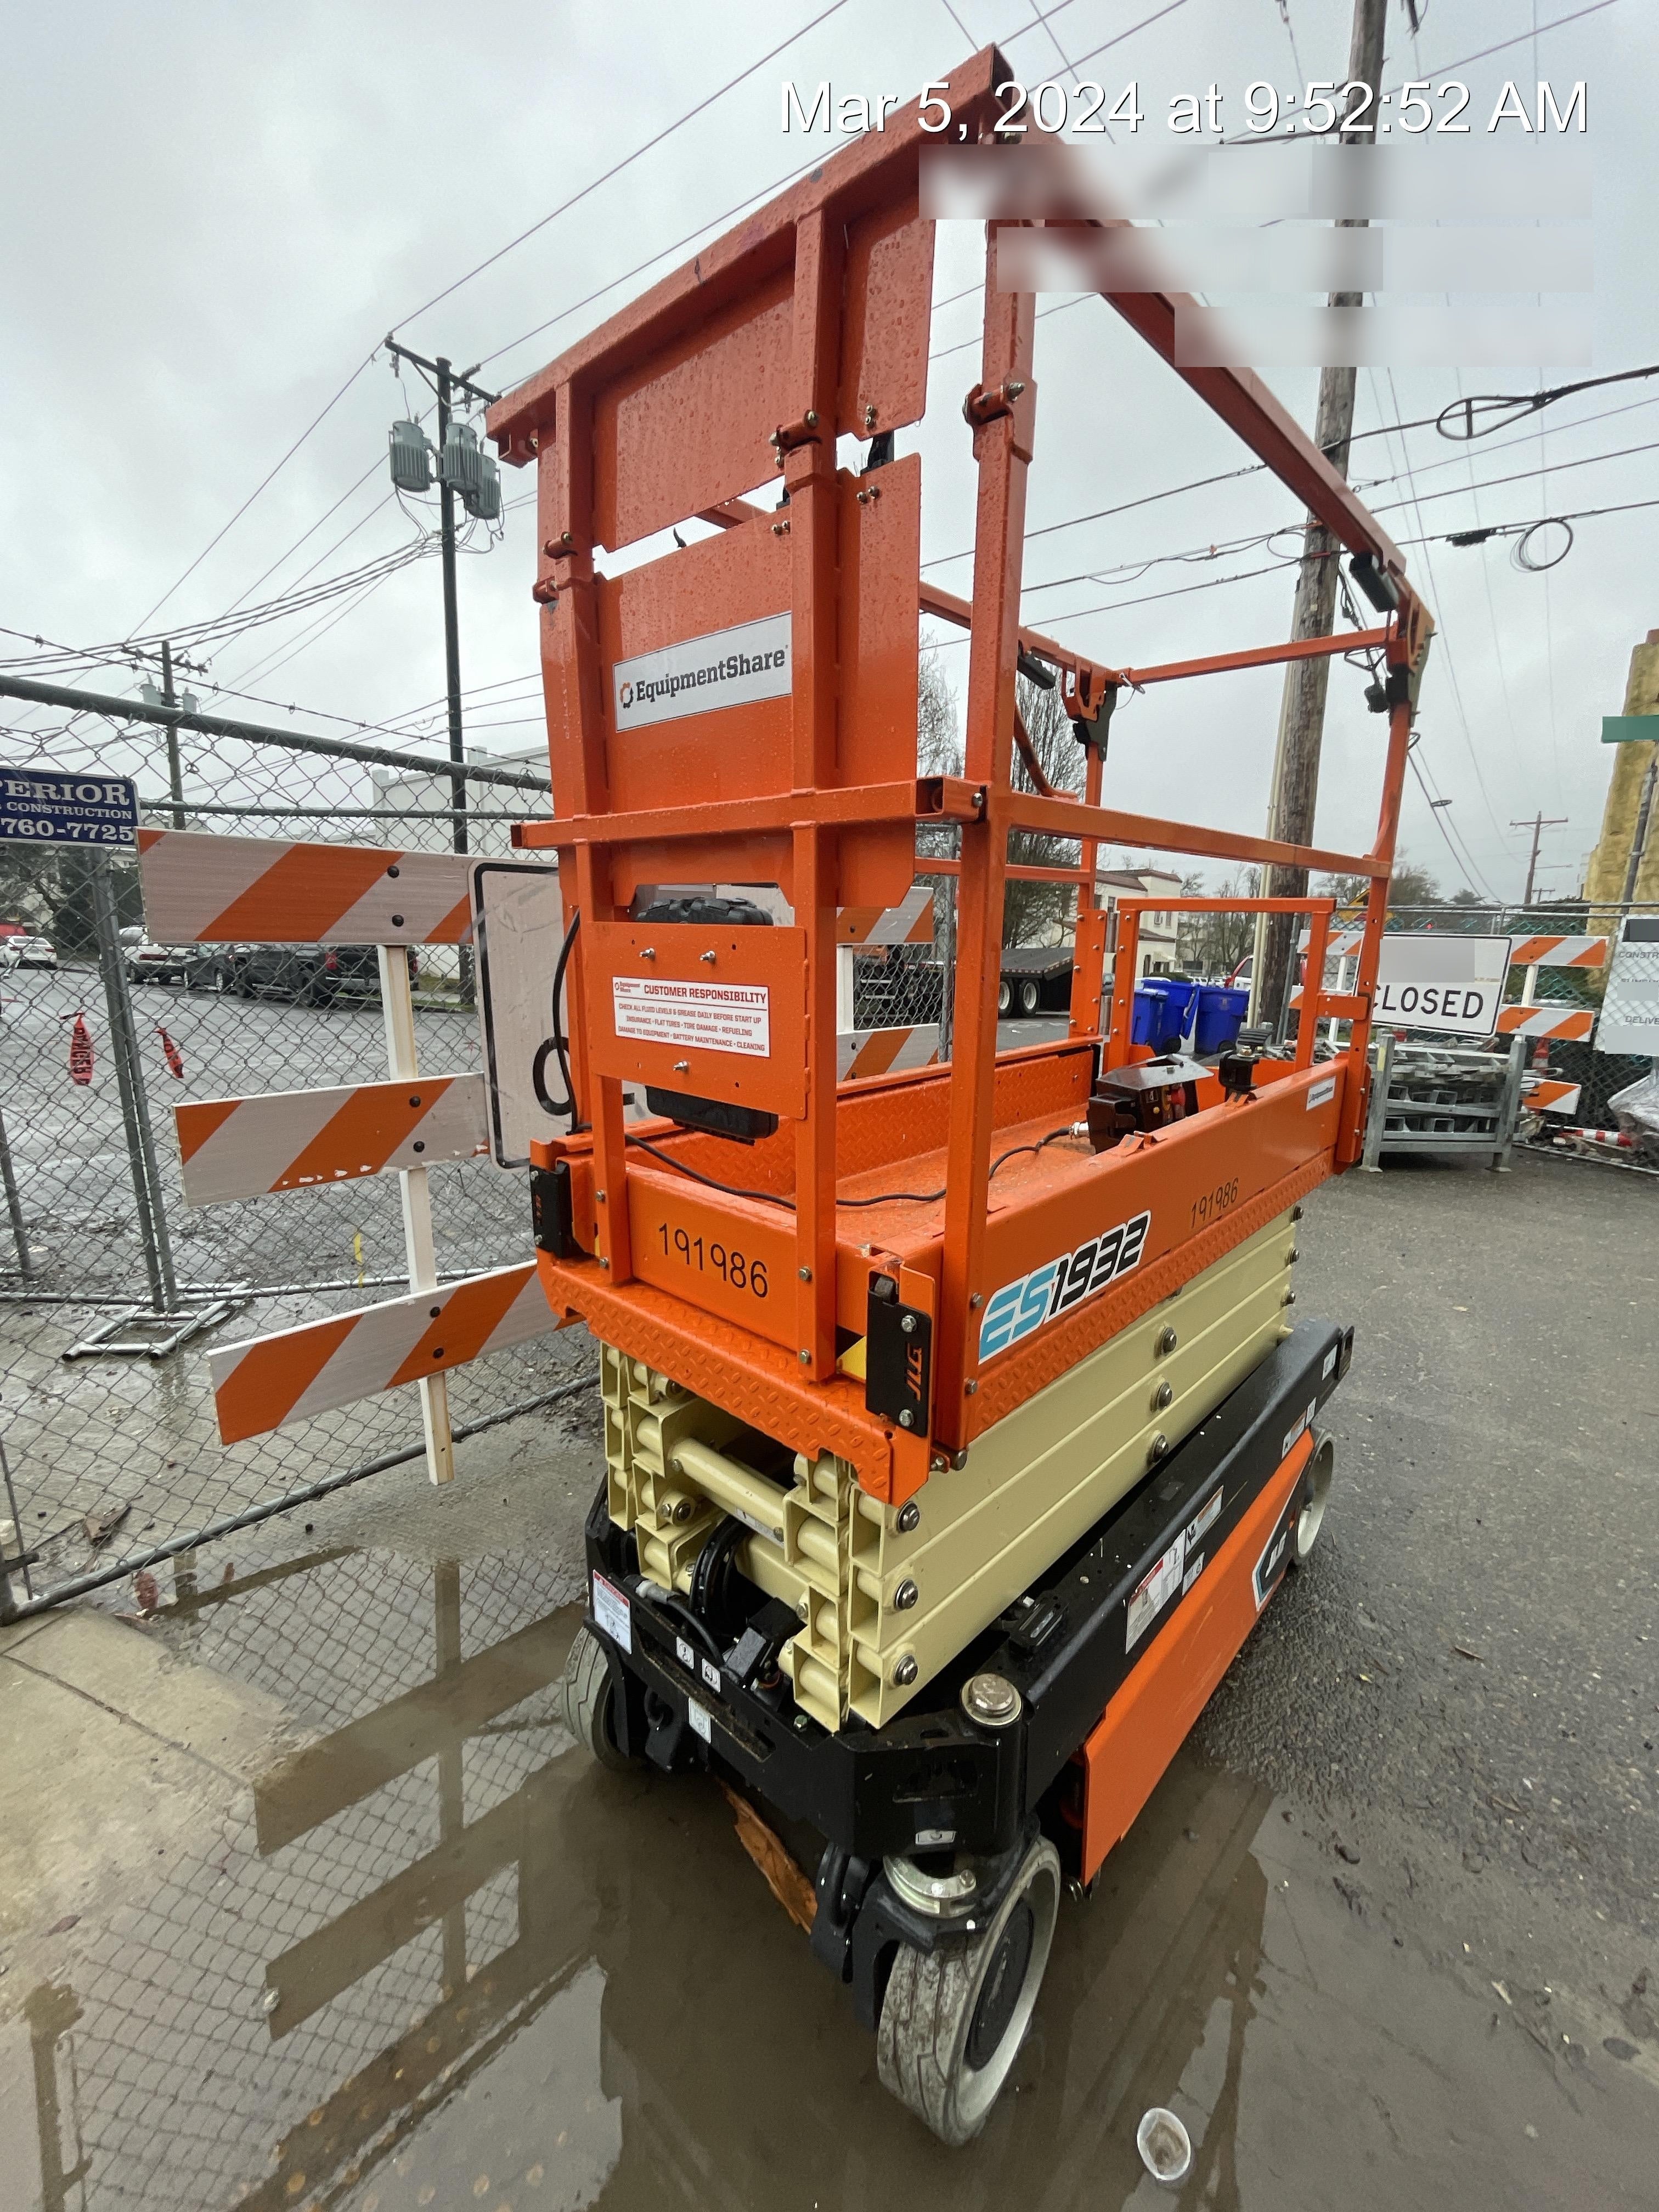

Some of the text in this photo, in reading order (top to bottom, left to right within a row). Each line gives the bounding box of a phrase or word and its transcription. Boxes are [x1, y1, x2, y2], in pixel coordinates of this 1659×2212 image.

[636, 648, 786, 702] EquipmentShare
[7, 802, 132, 820] CONSTRUCTION
[1, 817, 134, 842] 760-7725
[644, 985, 766, 1003] CUSTOMER RESPONSIBILITY
[627, 1015, 652, 1024] INSURANCE
[696, 1024, 718, 1032] DAMAGE
[722, 1026, 752, 1036] REFUELING
[678, 1009, 697, 1018] GREASE
[713, 1013, 733, 1022] BEFORE
[735, 1015, 752, 1023] START
[618, 1025, 635, 1034] DAMAGE
[643, 1029, 669, 1039] EQUIPMENT
[673, 1032, 693, 1041] BATTERY
[695, 1036, 732, 1047] MAINTENANCE
[737, 1041, 765, 1051] CLEANING
[1190, 1177, 1239, 1229] 191986
[658, 1223, 769, 1298] 191986
[978, 1214, 1149, 1362] ES1932
[907, 1343, 922, 1403] JLG
